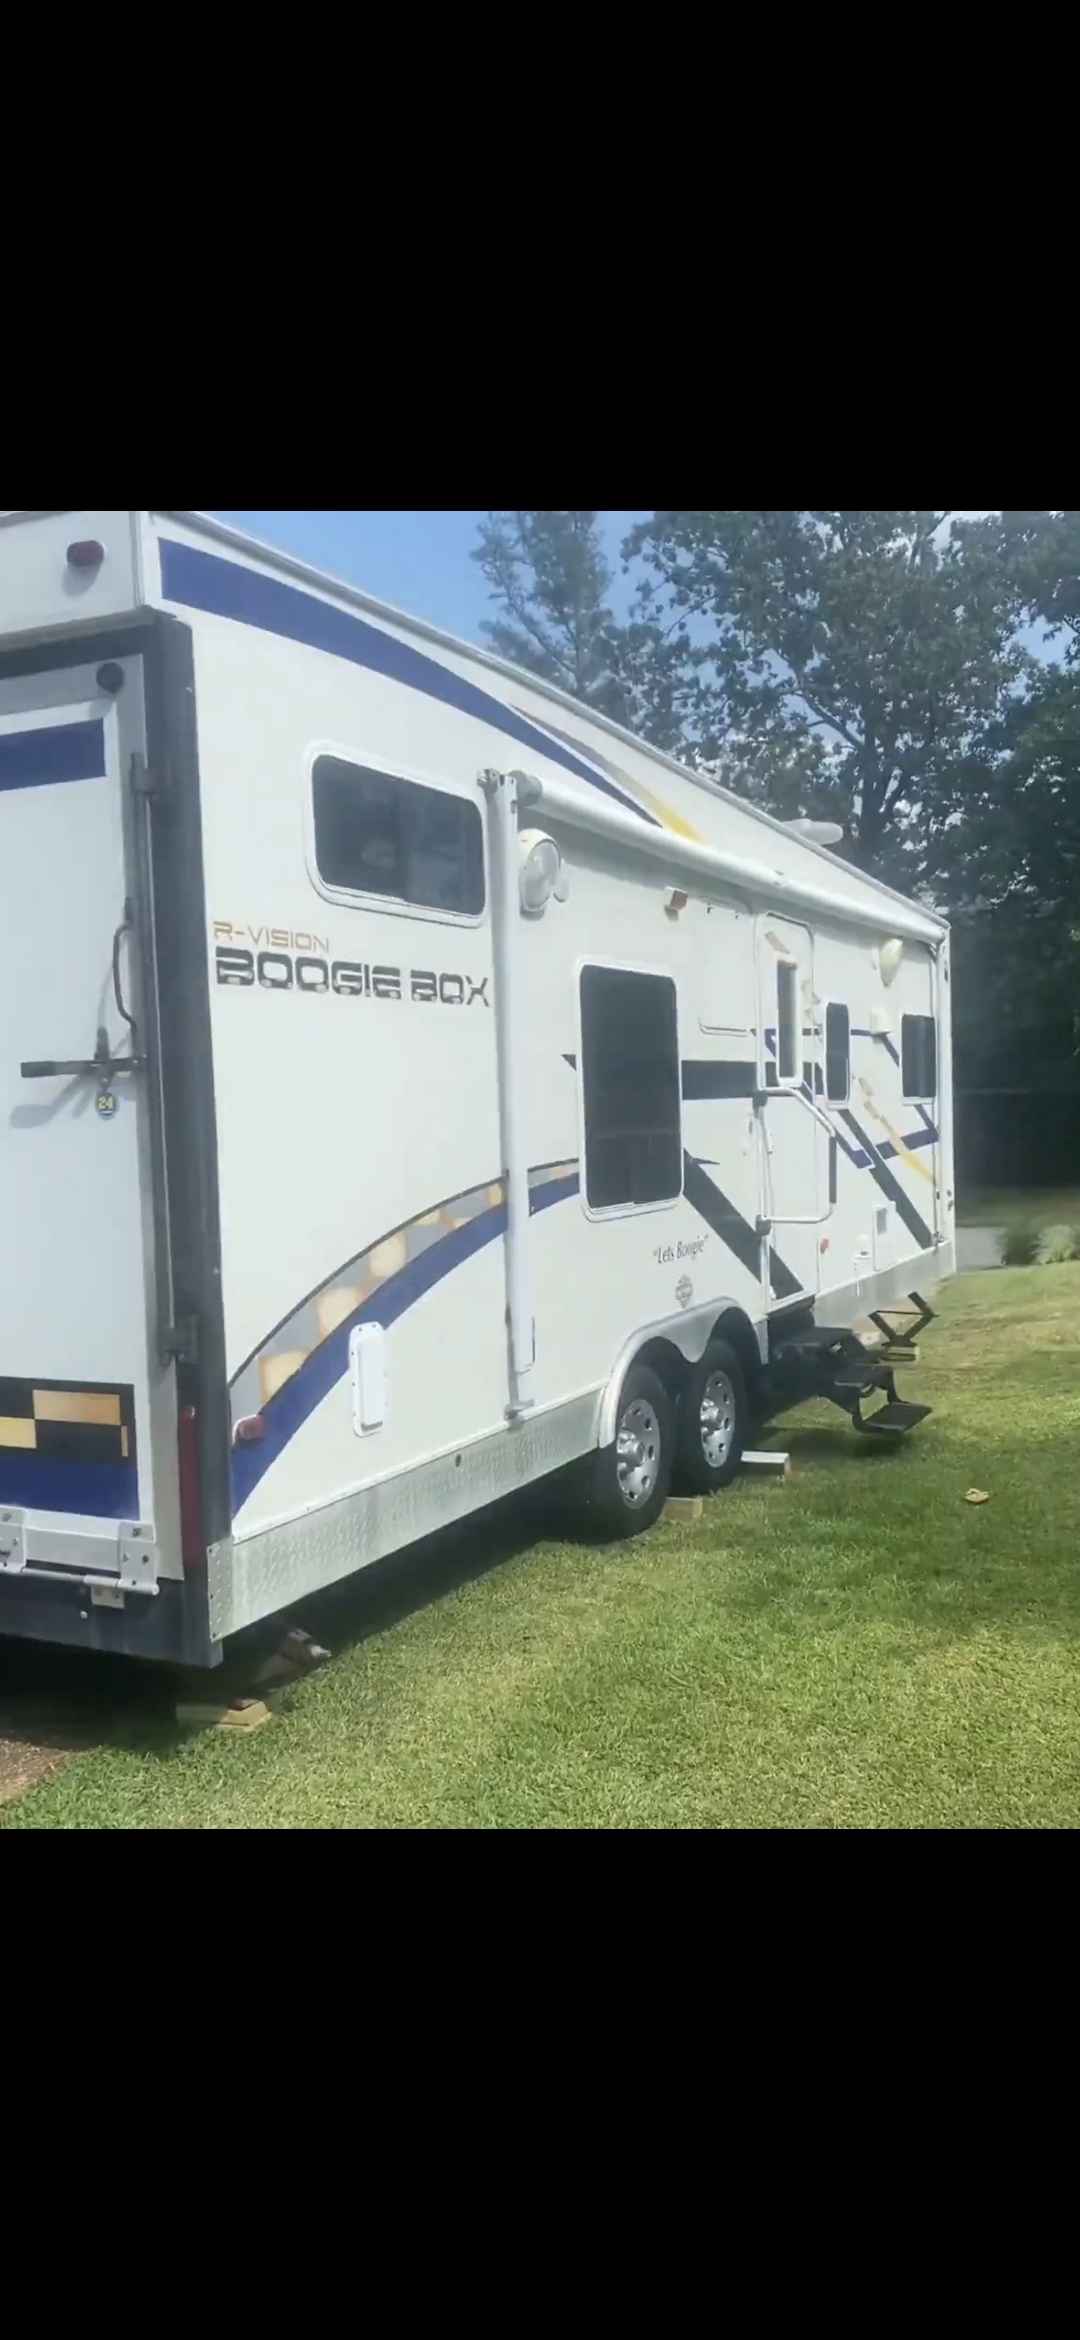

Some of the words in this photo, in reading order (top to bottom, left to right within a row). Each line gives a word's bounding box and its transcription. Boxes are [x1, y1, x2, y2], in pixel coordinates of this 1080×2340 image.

[213, 921, 329, 952] R-VISION
[216, 946, 402, 1000] BOOGIE
[410, 969, 490, 1007] BOX
